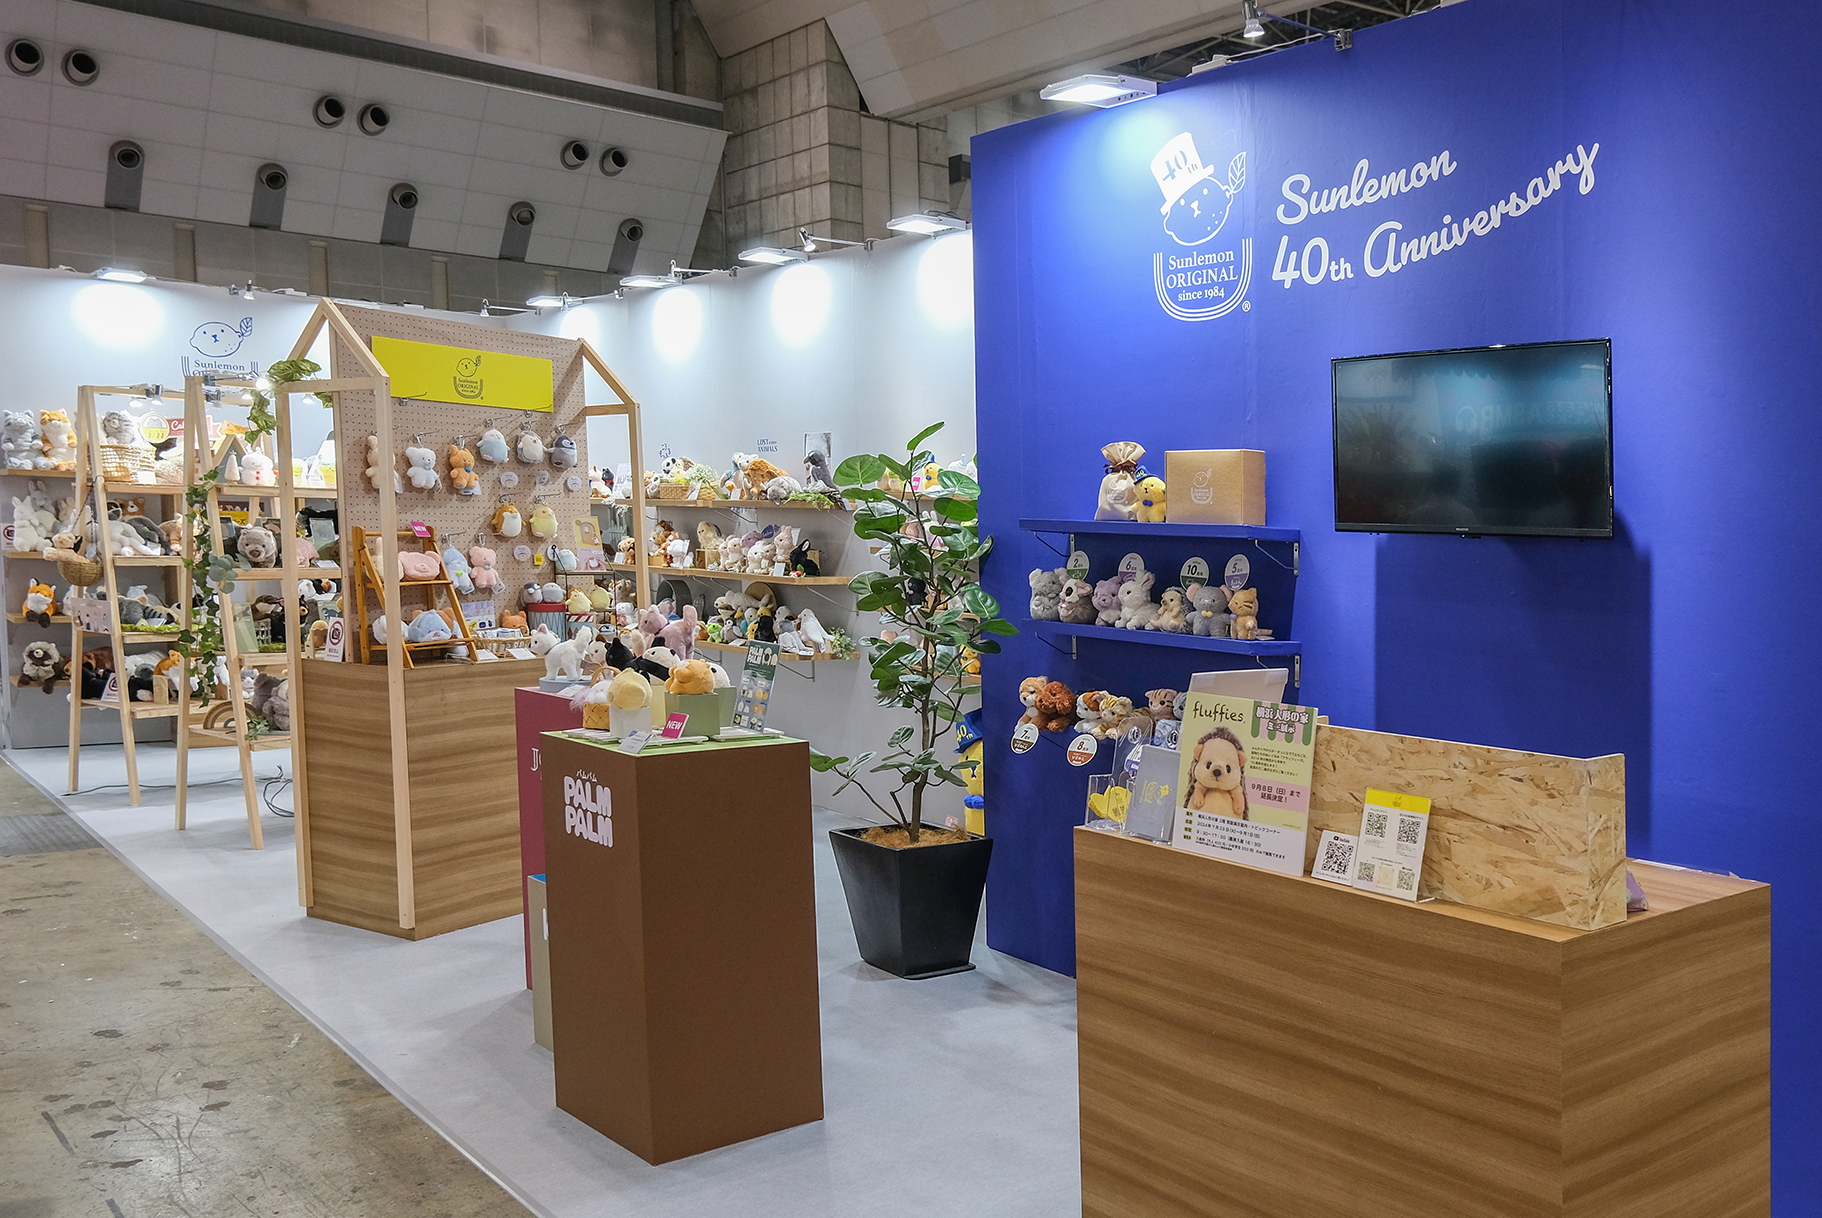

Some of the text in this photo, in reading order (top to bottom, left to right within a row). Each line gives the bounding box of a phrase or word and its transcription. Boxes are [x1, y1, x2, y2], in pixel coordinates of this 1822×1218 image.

[1275, 150, 1457, 225] Sunlemon
[1272, 142, 1600, 289] 40th Anniversary
[1168, 250, 1235, 271] Sunlemon
[1166, 265, 1239, 289] ORIGINAL
[1177, 286, 1226, 302] since 1984
[194, 360, 245, 372] Sunlemon
[1193, 701, 1244, 723] fluffies
[666, 720, 682, 730] NEW
[563, 775, 612, 818] PALM
[565, 805, 614, 848] PALM
